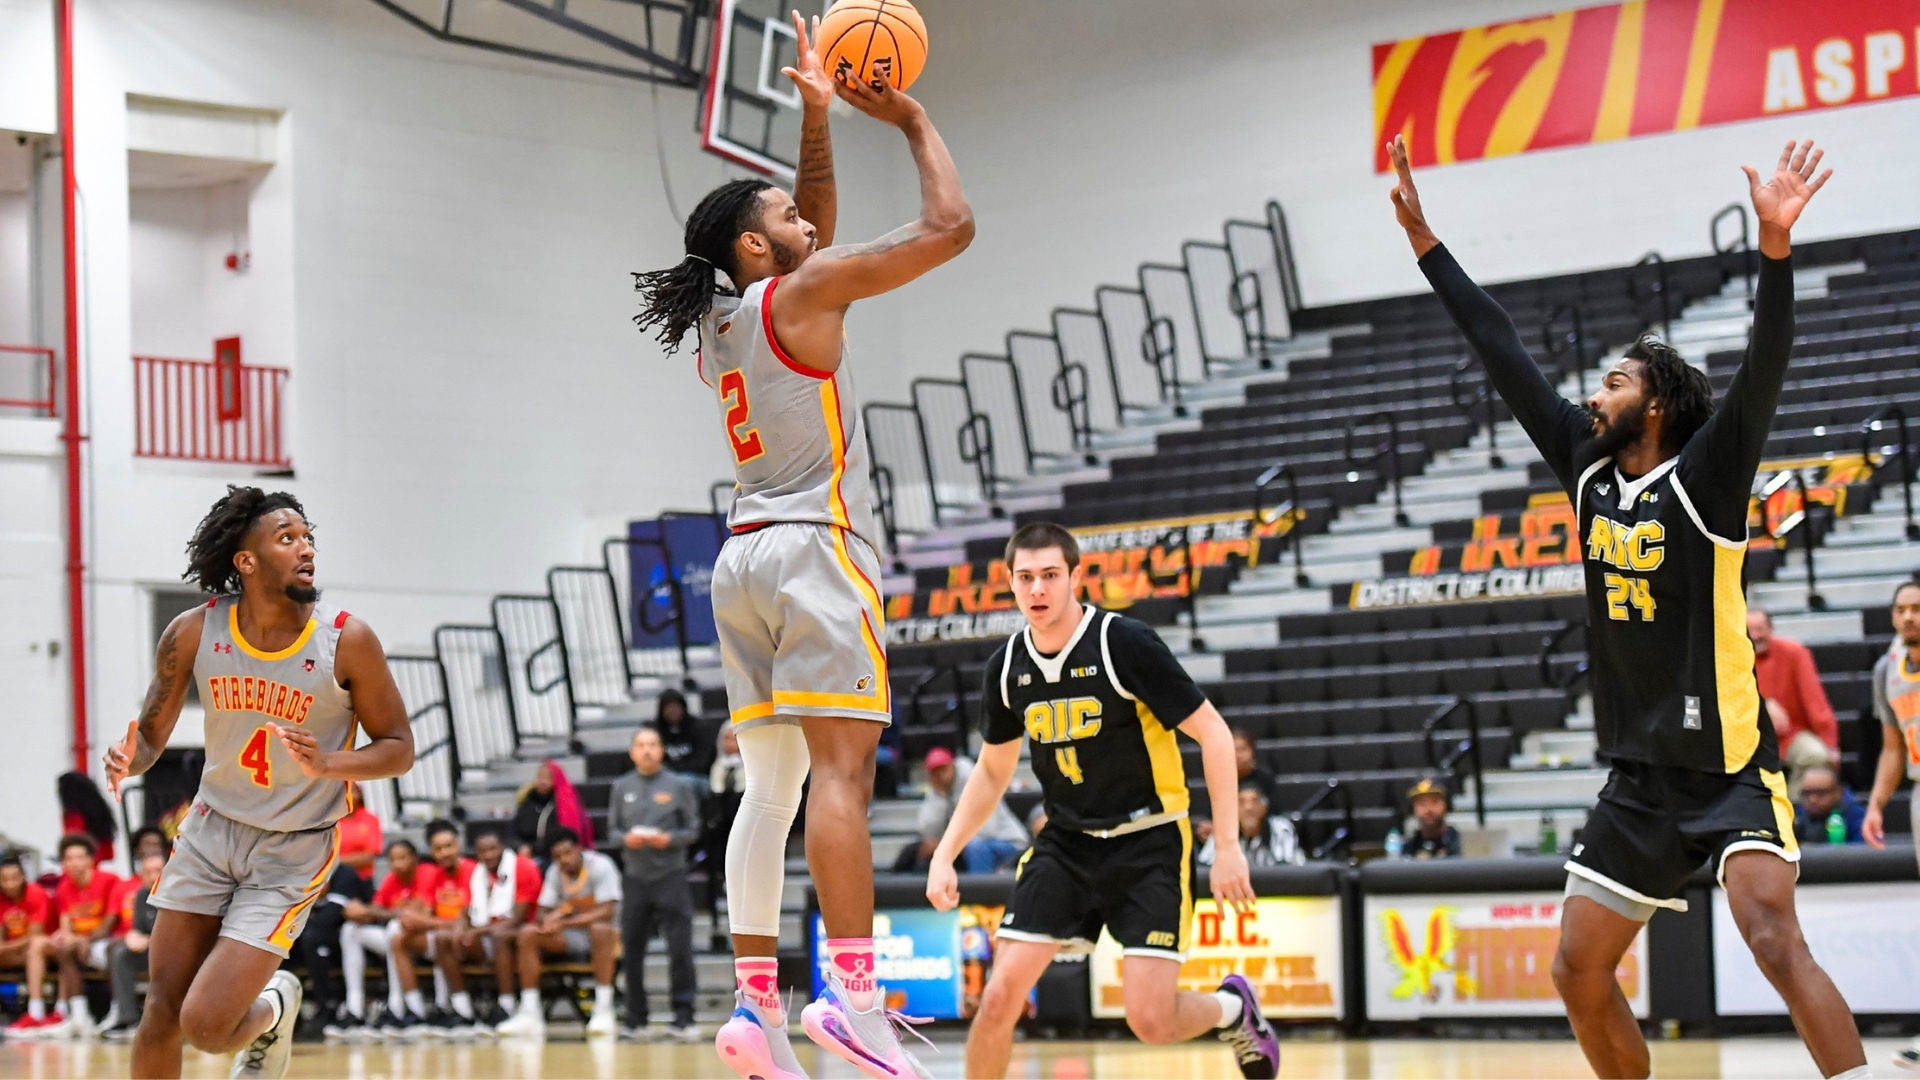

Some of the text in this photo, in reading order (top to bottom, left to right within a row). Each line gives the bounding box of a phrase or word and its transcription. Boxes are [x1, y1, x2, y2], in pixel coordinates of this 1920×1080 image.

[1762, 26, 1920, 112] ASP
[719, 367, 766, 466] 2
[1587, 514, 1665, 571] AIC
[1358, 572, 1460, 608] DISTRICT
[1604, 572, 1657, 622] 24
[208, 675, 315, 726] FIREBIRDS
[1024, 695, 1103, 744] AIC
[238, 726, 272, 789] 4
[1055, 746, 1084, 786] 4
[1146, 930, 1176, 948] AIC
